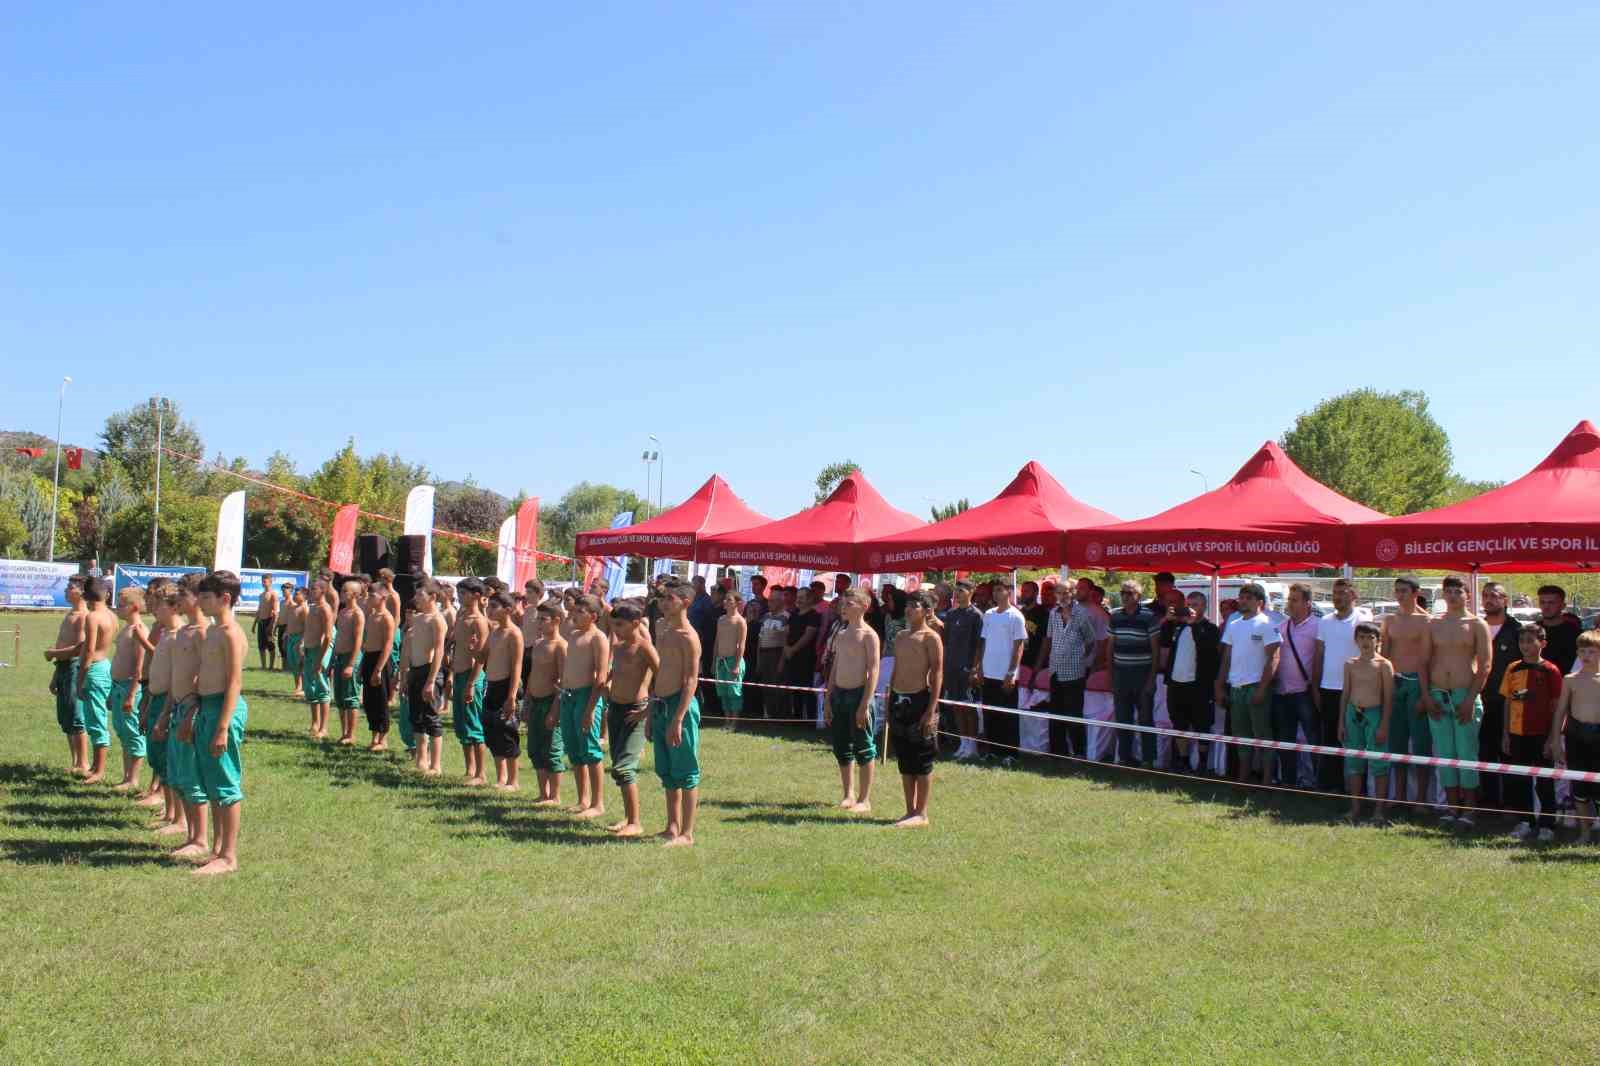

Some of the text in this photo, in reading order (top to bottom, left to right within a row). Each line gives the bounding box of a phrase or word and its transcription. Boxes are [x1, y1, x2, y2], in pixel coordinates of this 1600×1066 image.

[885, 552, 911, 563] BİLECİK
[912, 548, 945, 561] GENÇLİK
[946, 546, 956, 556] VE
[956, 546, 978, 556] SPOR
[980, 544, 988, 556] İL
[1106, 540, 1320, 556] BİLECİK GENÇLİK VE SPOR İL MÜDÜRLÜĞÜ
[1404, 536, 1600, 554] BİLECİK GENÇLİK VE SPOR İL
